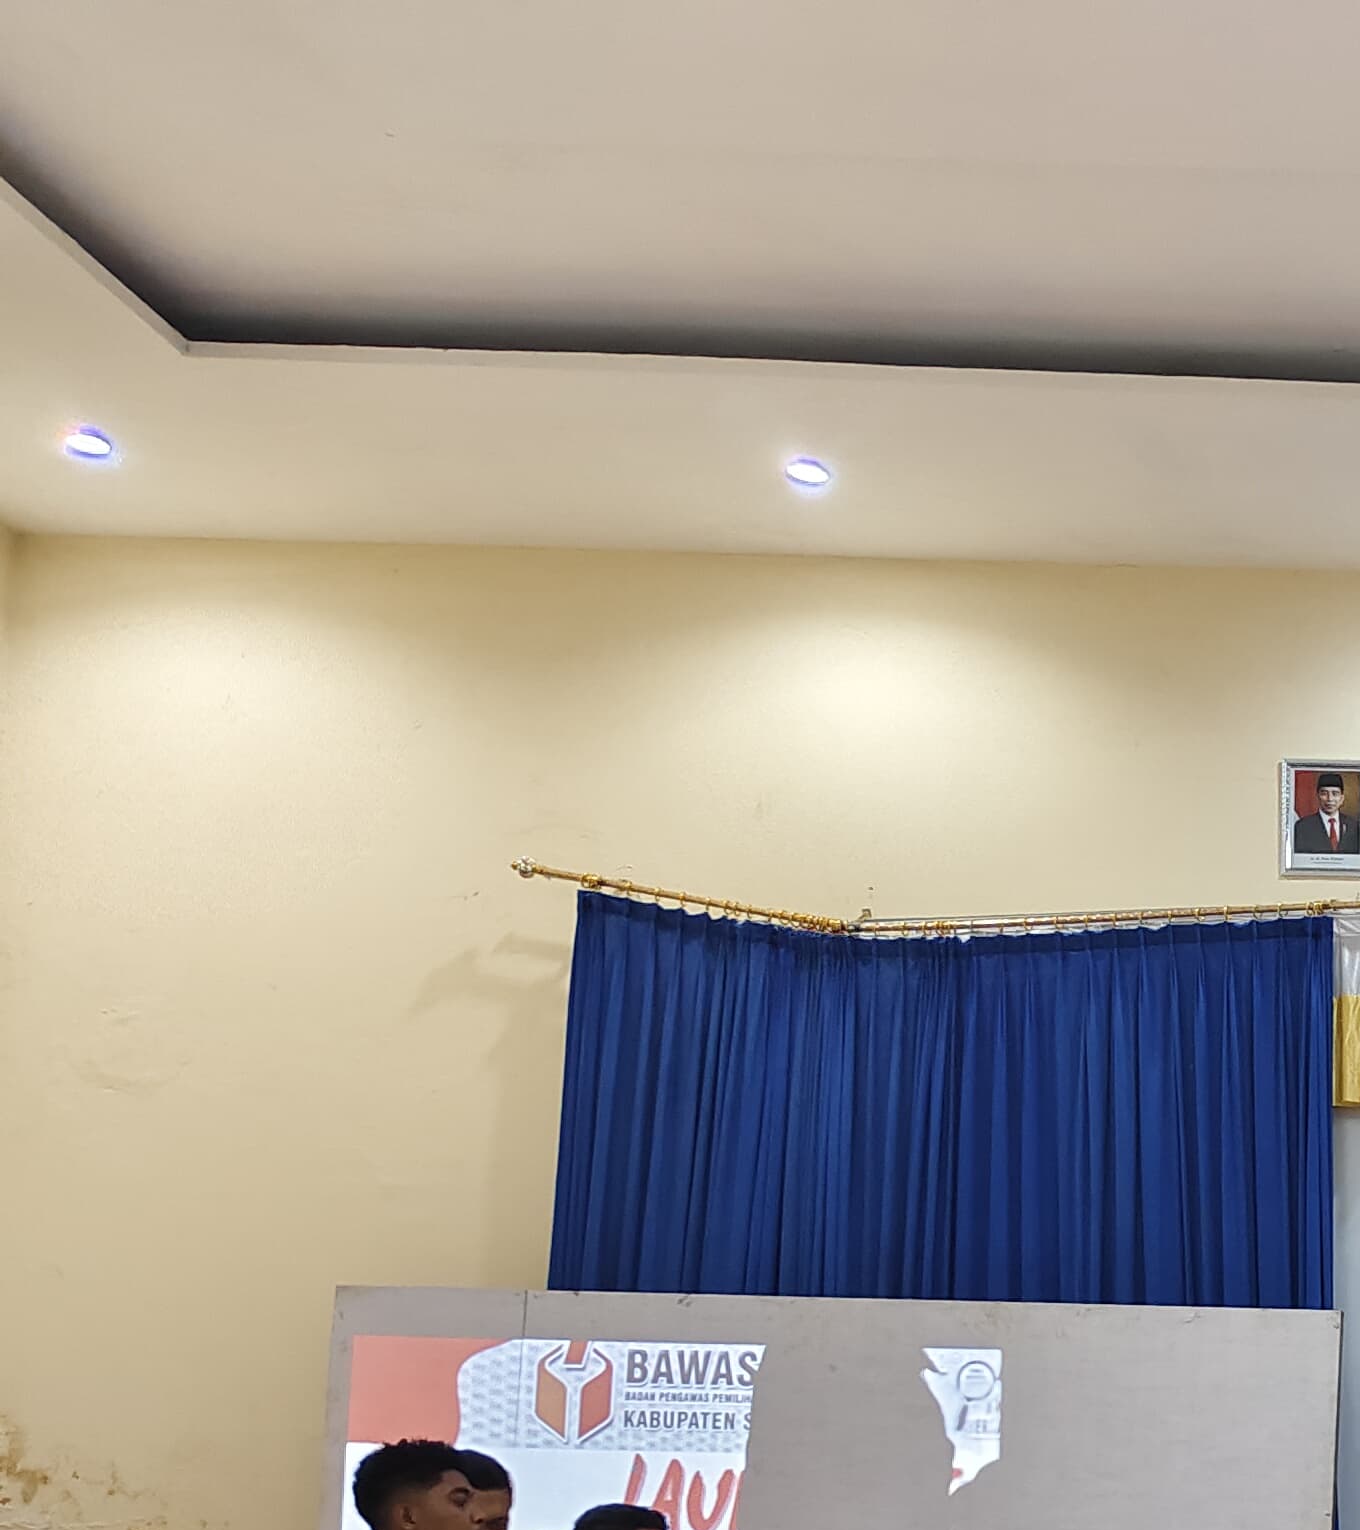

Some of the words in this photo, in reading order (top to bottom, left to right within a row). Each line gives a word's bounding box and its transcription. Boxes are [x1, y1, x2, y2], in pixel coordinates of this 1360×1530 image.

[626, 1349, 759, 1387] BAWAS
[624, 1391, 656, 1401] BADAN
[658, 1391, 710, 1403] PENGAWAS
[624, 1409, 736, 1431] KABUPATEN
